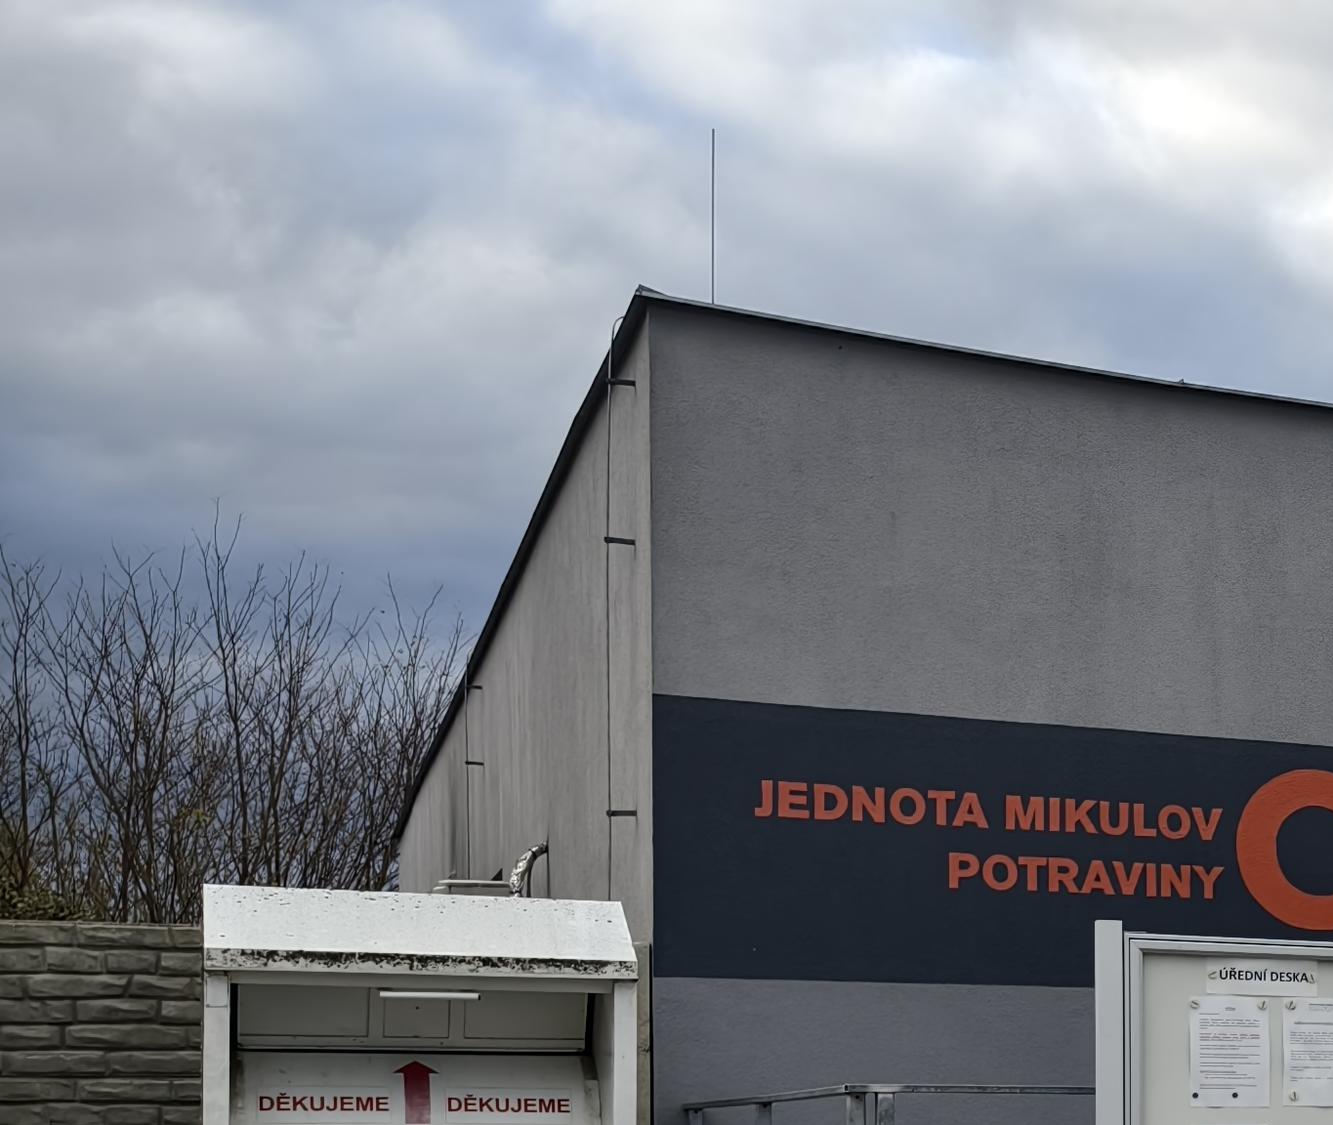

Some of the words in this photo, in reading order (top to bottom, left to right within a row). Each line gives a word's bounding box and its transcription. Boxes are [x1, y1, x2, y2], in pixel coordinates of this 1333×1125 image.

[755, 779, 989, 829] JEDNOTA
[1005, 794, 1224, 841] MIKULOV
[947, 852, 1225, 899] POTRAVINY
[1219, 967, 1268, 981] ÚŘEDNÍ
[1270, 971, 1309, 983] DESKA
[258, 1092, 390, 1112] DĚKUJEME
[447, 1094, 571, 1113] DĚKUJEME
